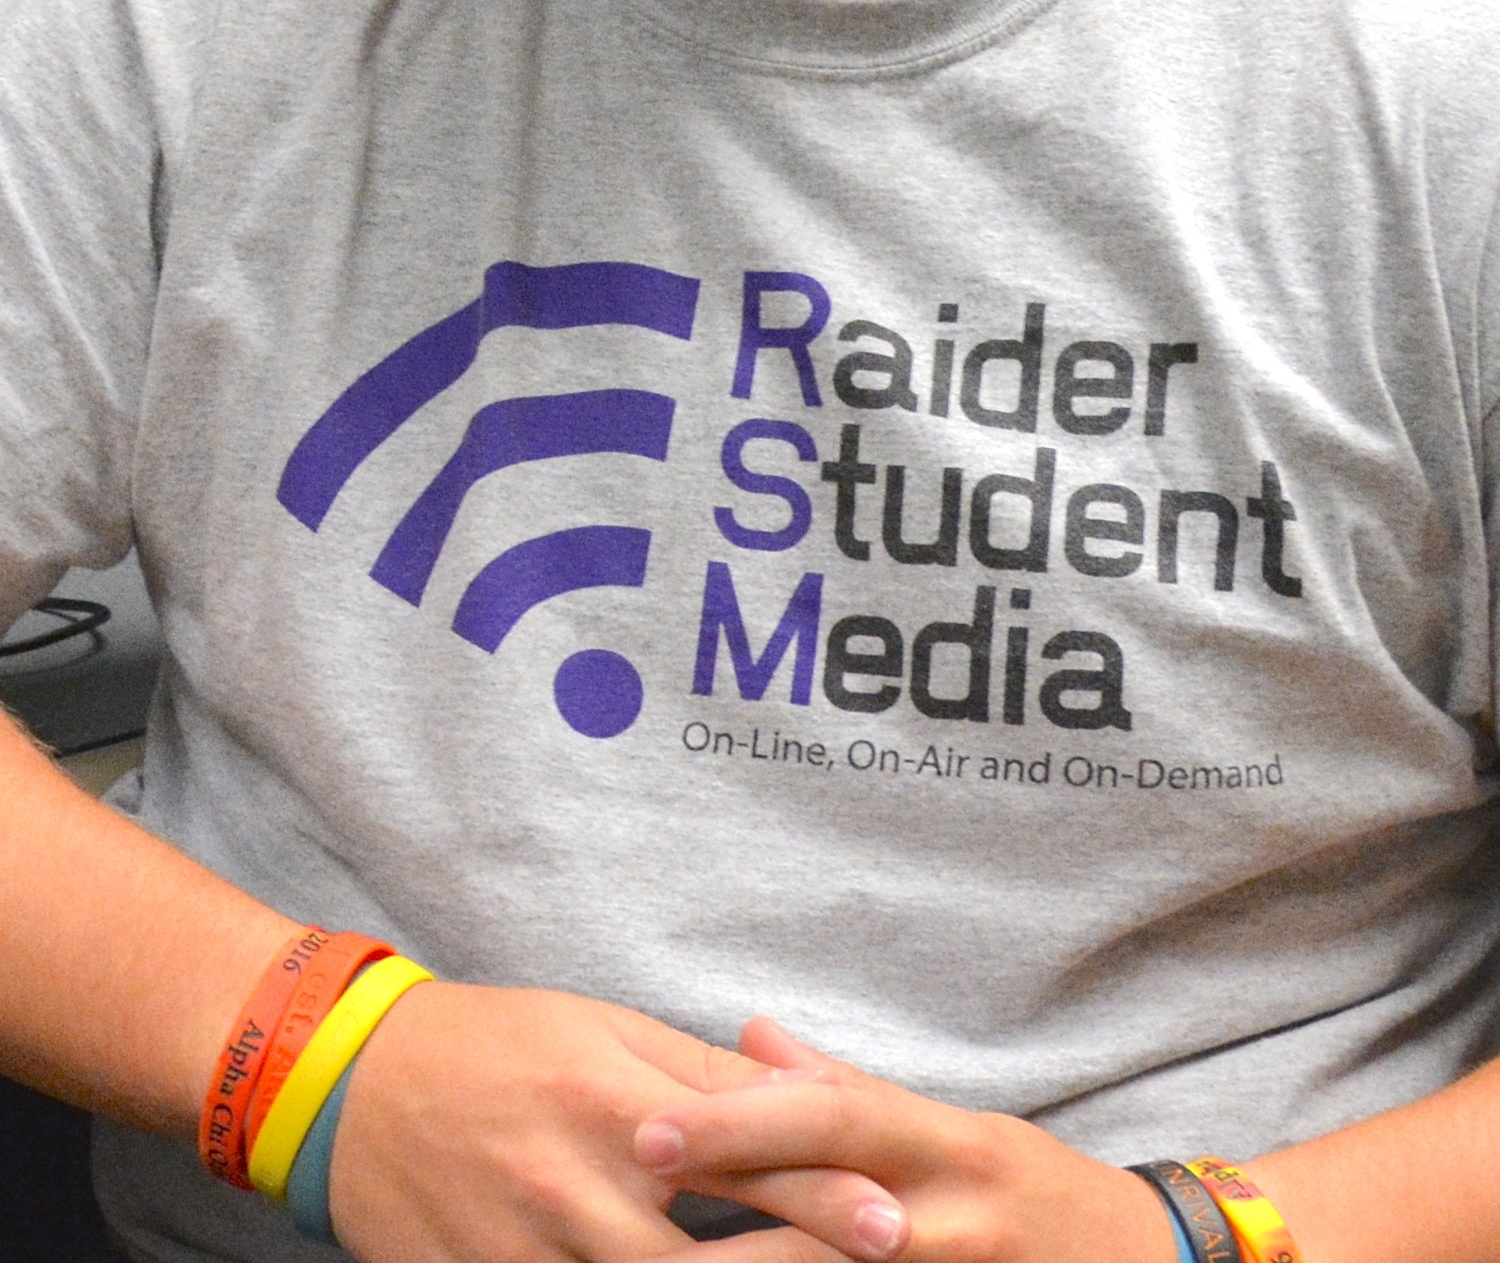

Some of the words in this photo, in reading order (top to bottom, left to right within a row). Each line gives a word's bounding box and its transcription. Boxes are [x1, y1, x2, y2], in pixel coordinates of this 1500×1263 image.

[731, 269, 1198, 437] Raider
[712, 417, 1303, 599] Student
[690, 560, 1132, 733] Media
[681, 721, 836, 771] On-Line,
[846, 739, 967, 779] On-Air
[980, 746, 1052, 785] and
[1062, 751, 1285, 790] On-Demand
[282, 931, 330, 976] 2016
[219, 1019, 266, 1097] Alpha
